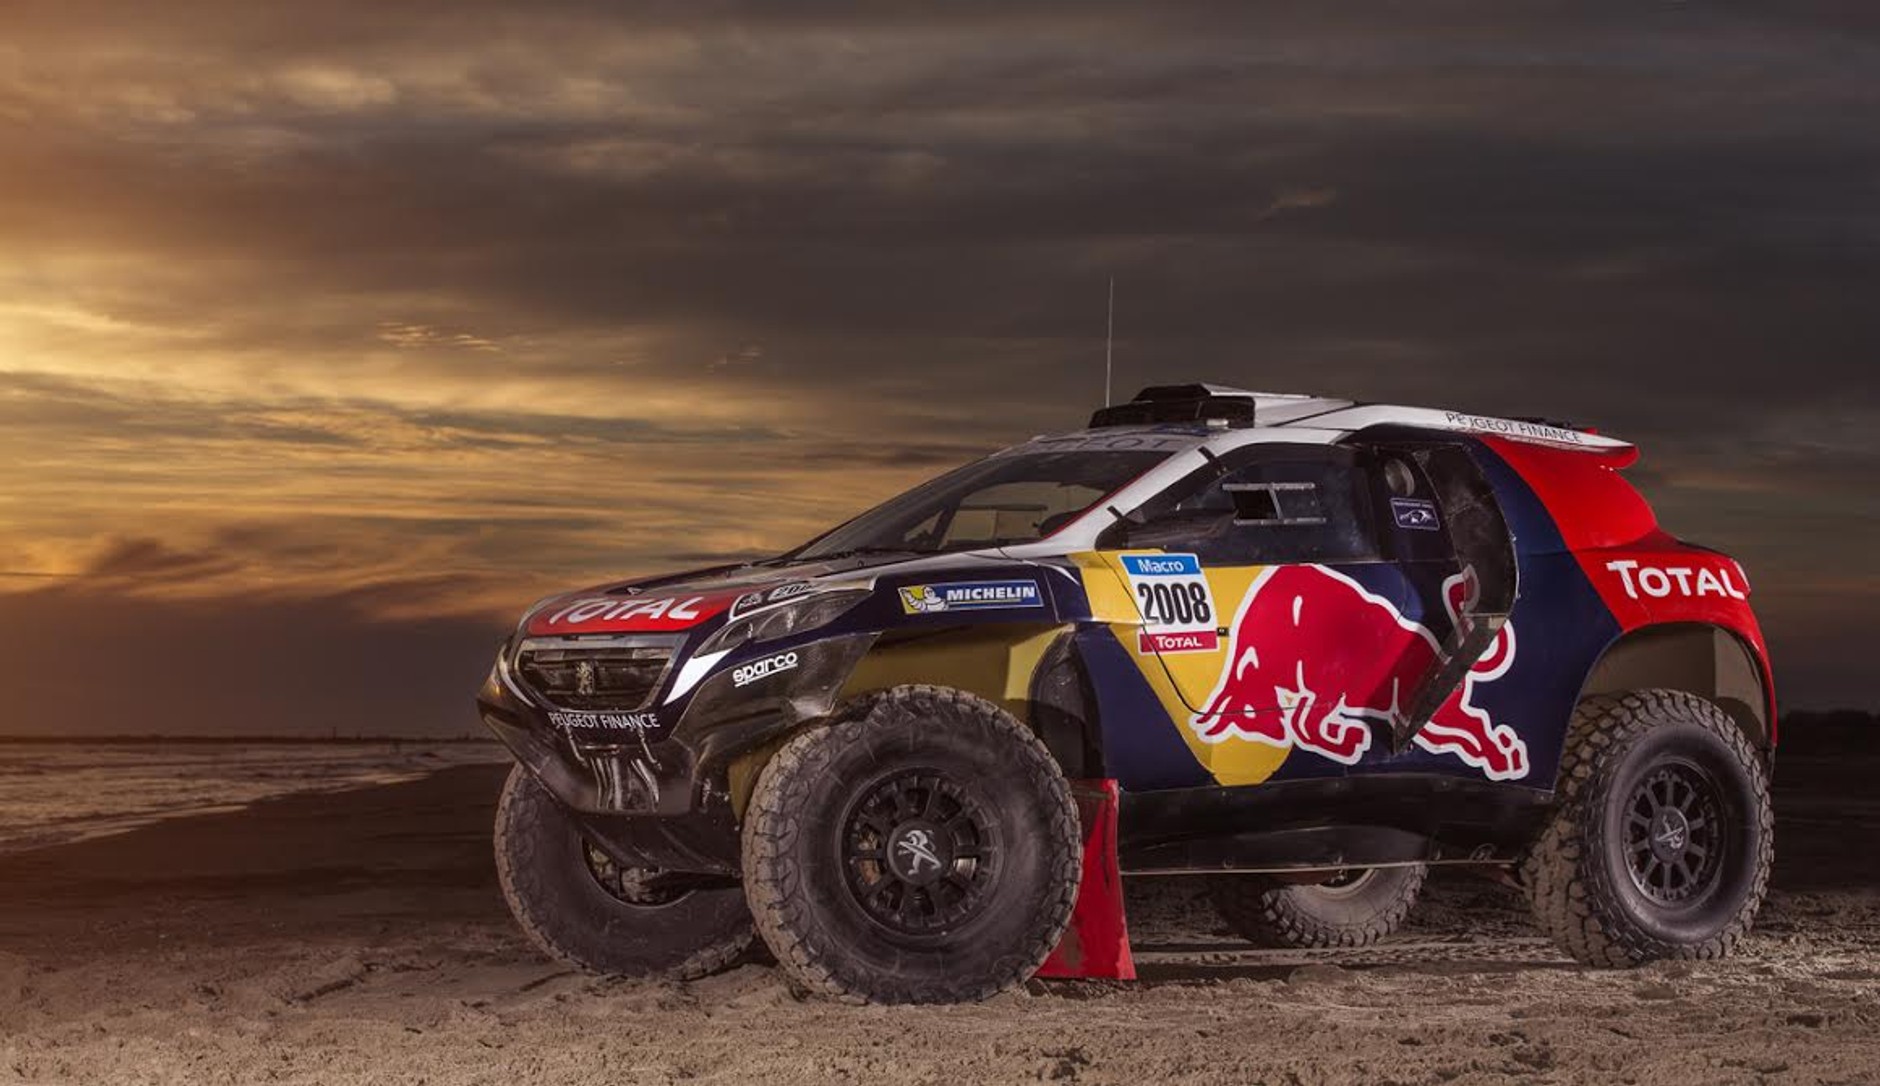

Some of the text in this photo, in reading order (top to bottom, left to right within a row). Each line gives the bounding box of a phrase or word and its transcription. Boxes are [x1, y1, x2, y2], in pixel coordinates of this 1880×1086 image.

[1518, 422, 1583, 442] FINANCE
[1137, 559, 1184, 573] Macro
[1606, 560, 1745, 600] TOTAL
[946, 586, 1035, 601] MICHELIN
[1137, 582, 1211, 624] 2008
[549, 597, 704, 625] TOTAL
[1156, 636, 1203, 649] TOTAL
[732, 651, 798, 685] sparco
[548, 711, 660, 729] PEUGEOT FINANCE
